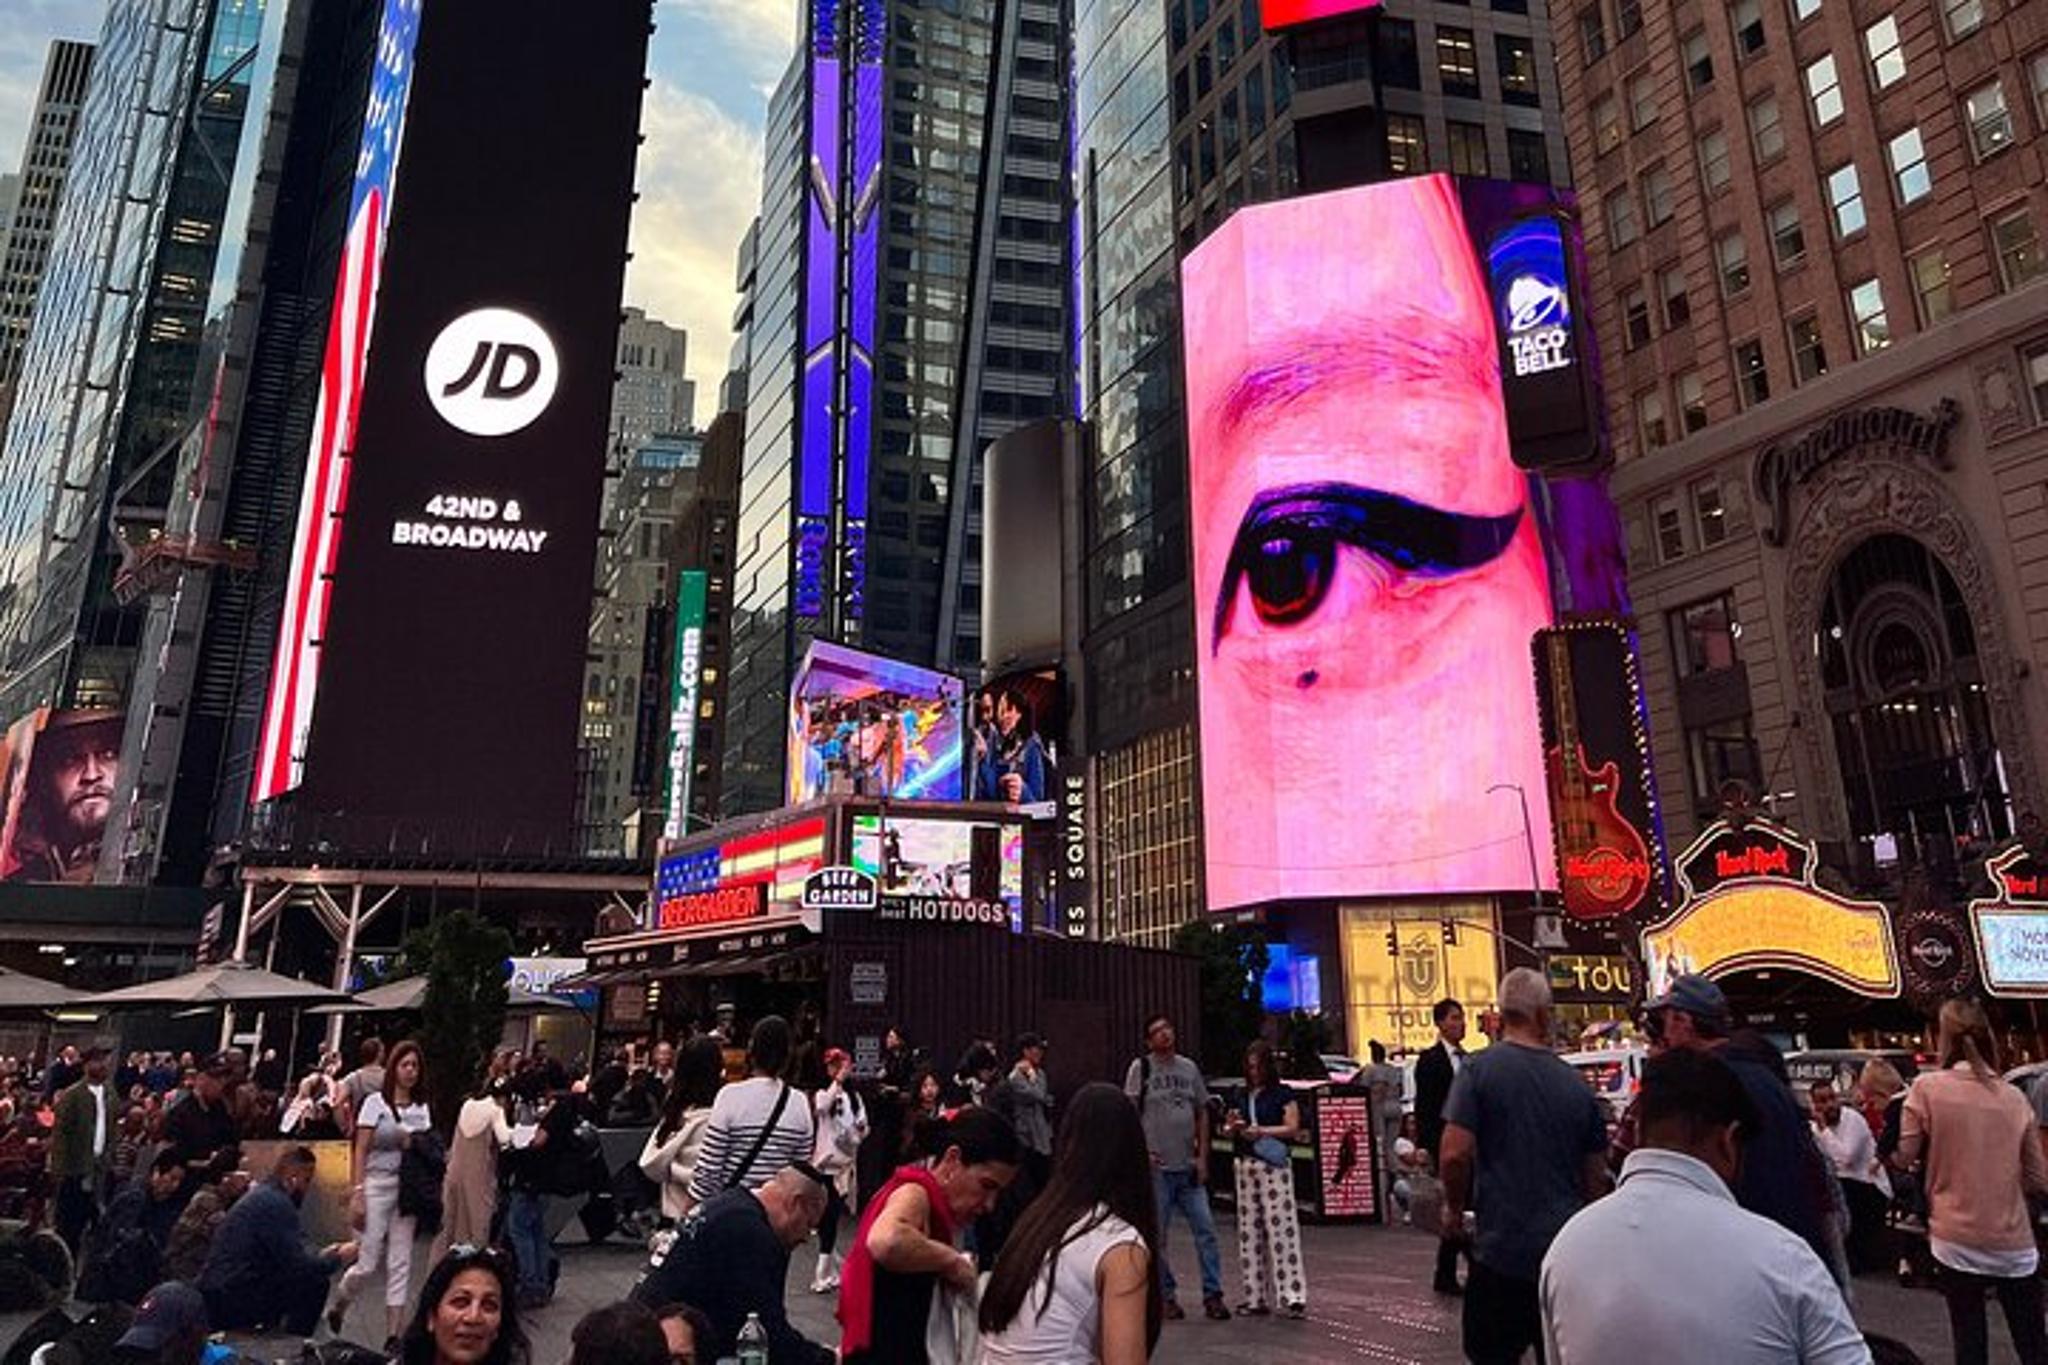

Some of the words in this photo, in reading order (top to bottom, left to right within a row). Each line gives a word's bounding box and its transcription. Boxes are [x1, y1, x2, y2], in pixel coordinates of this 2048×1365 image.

[1507, 329, 1567, 357] TACO
[442, 341, 541, 401] JD
[1515, 347, 1571, 376] BELL
[1752, 397, 1962, 547] Paramount
[425, 494, 498, 519] 42ND
[503, 500, 522, 521] &
[392, 522, 547, 552] BROADWAY
[1066, 776, 1085, 879] SQUARE
[809, 889, 868, 904] GARDEN
[909, 898, 1004, 923] HOTDOGS
